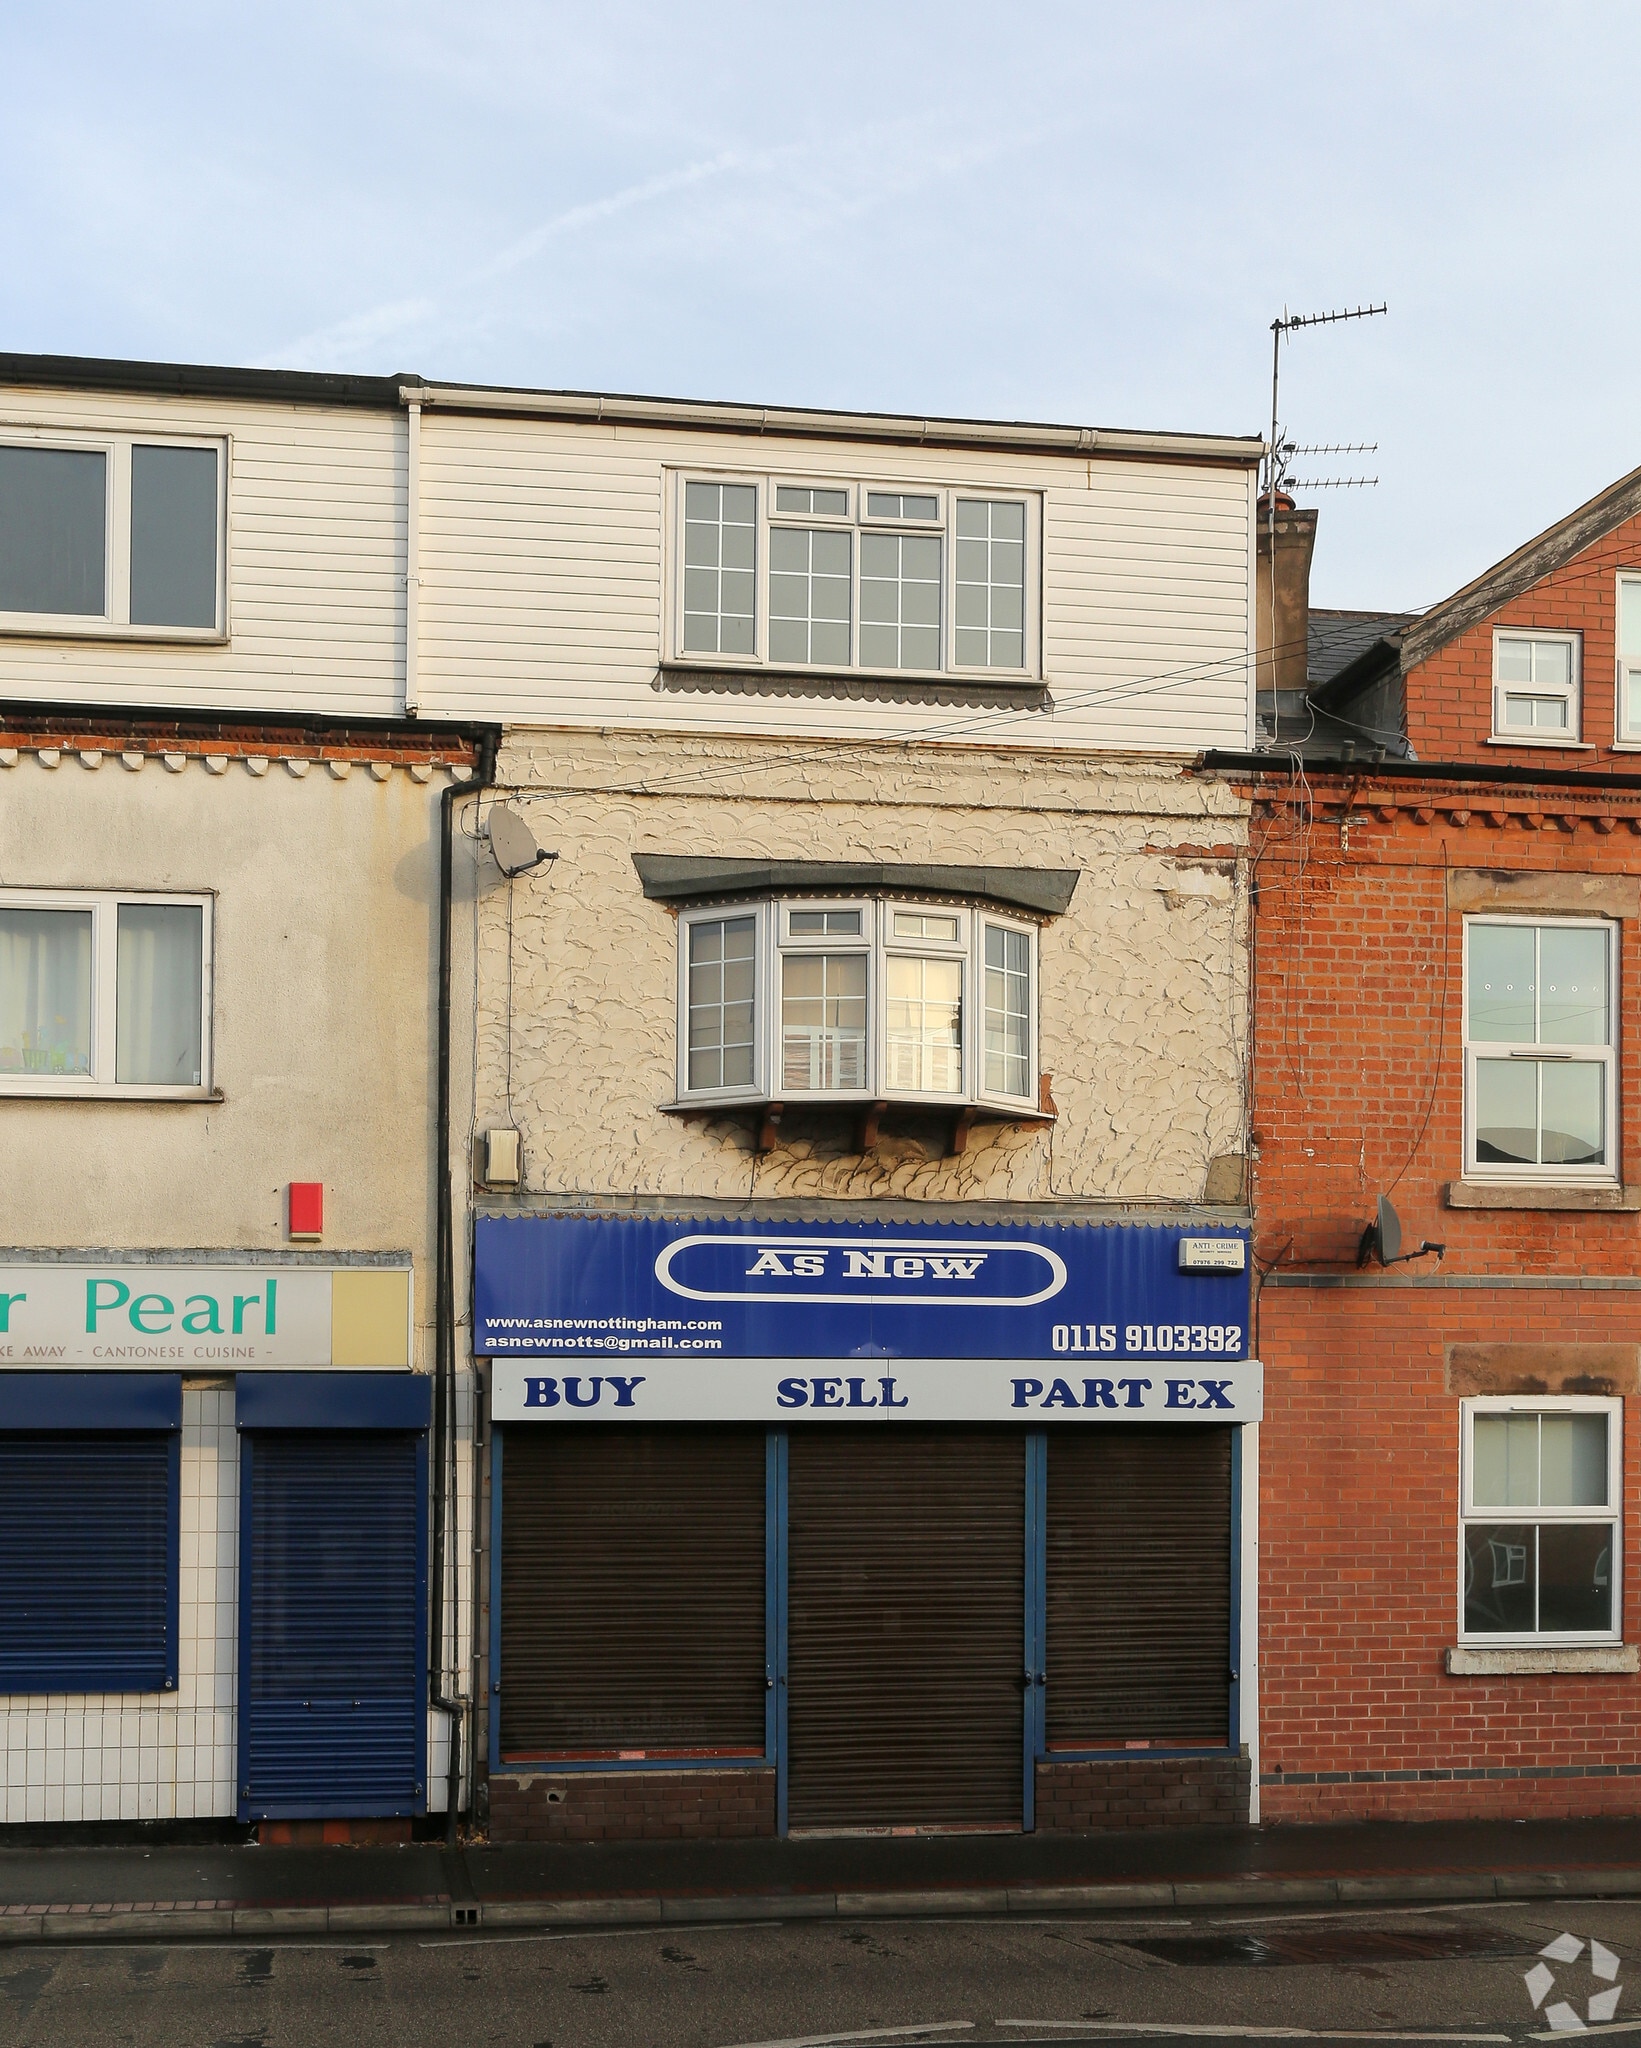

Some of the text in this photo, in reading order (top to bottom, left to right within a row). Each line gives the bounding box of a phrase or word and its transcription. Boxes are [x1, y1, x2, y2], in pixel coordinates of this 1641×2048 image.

[0, 1278, 278, 1335] r Pearl
[485, 1316, 723, 1332] www.asnewnottingham.com
[485, 1335, 723, 1350] asnewnotts@gmail.com
[1052, 1324, 1242, 1353] 0115 9103392
[23, 1345, 67, 1357] AWAY
[92, 1345, 185, 1359] CANTONESE
[193, 1346, 256, 1359] CUISINE
[523, 1376, 1236, 1409] BUY SELL PART EX
